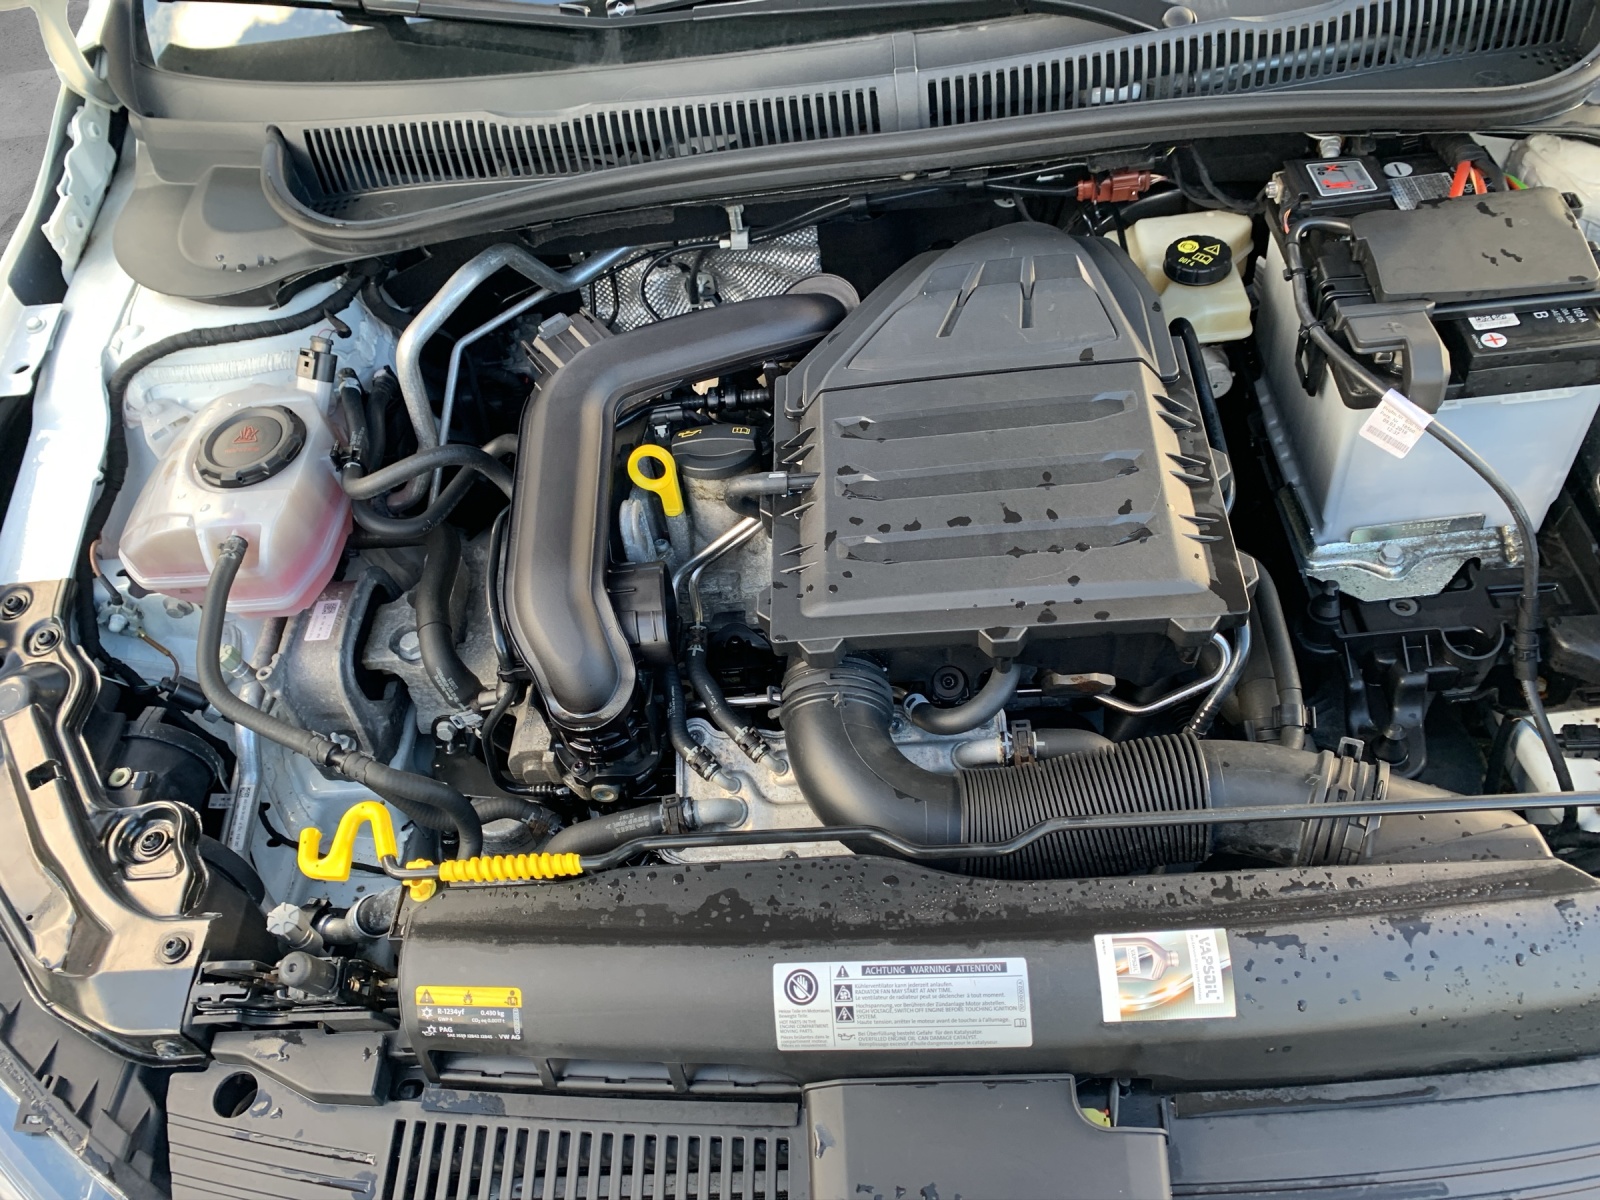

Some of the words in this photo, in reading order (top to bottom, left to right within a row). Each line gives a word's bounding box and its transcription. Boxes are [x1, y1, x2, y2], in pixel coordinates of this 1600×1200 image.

[1533, 310, 1549, 319] B
[865, 966, 906, 975] ACHTUNG
[910, 965, 951, 974] WARNING
[955, 964, 1001, 973] ATTENTION
[437, 1008, 465, 1016] R-1234yf
